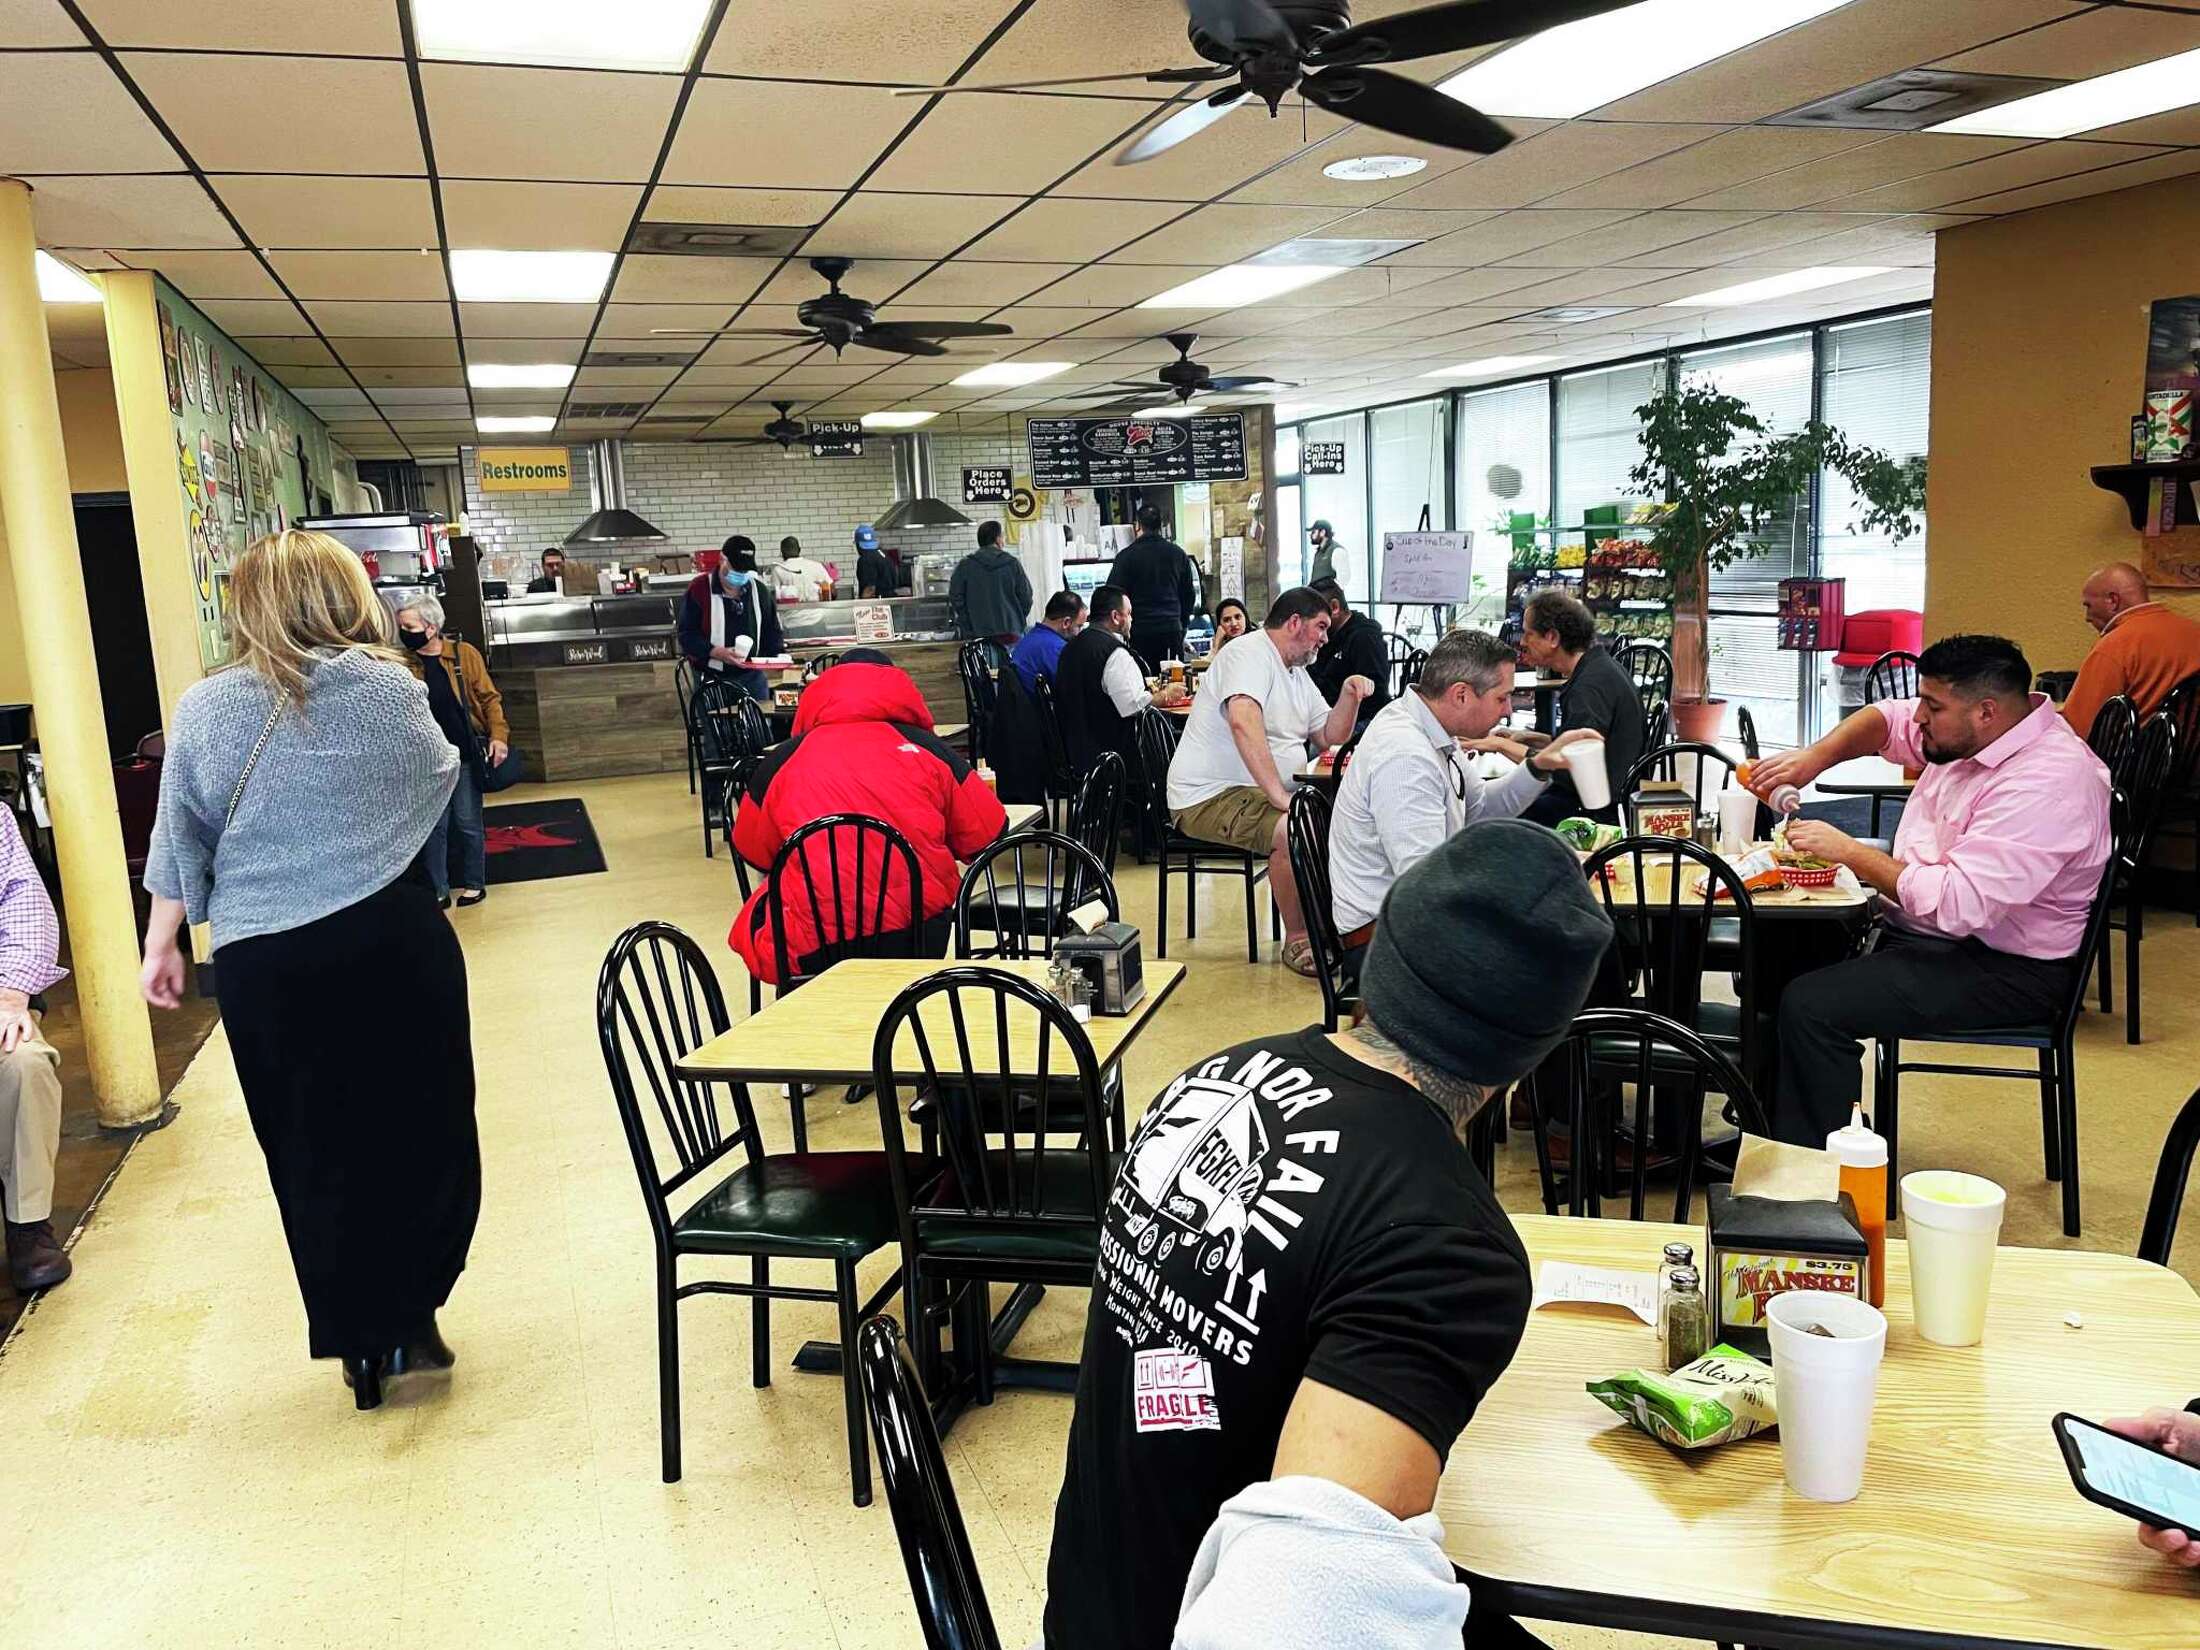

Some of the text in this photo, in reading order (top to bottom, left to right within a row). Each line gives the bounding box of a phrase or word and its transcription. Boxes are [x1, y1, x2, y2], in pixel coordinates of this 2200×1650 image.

[812, 422, 860, 433] Pick-Up
[481, 461, 568, 480] Restrooms
[971, 470, 1003, 479] Place
[969, 478, 1007, 487] Orders
[974, 486, 1002, 495] Here
[1230, 1049, 1334, 1123] NOR
[1805, 1260, 1853, 1271] $3.75
[1735, 1269, 1857, 1300] MANSKE
[1158, 1284, 1254, 1366] MOVERS
[1137, 1393, 1213, 1419] FRAGILE
